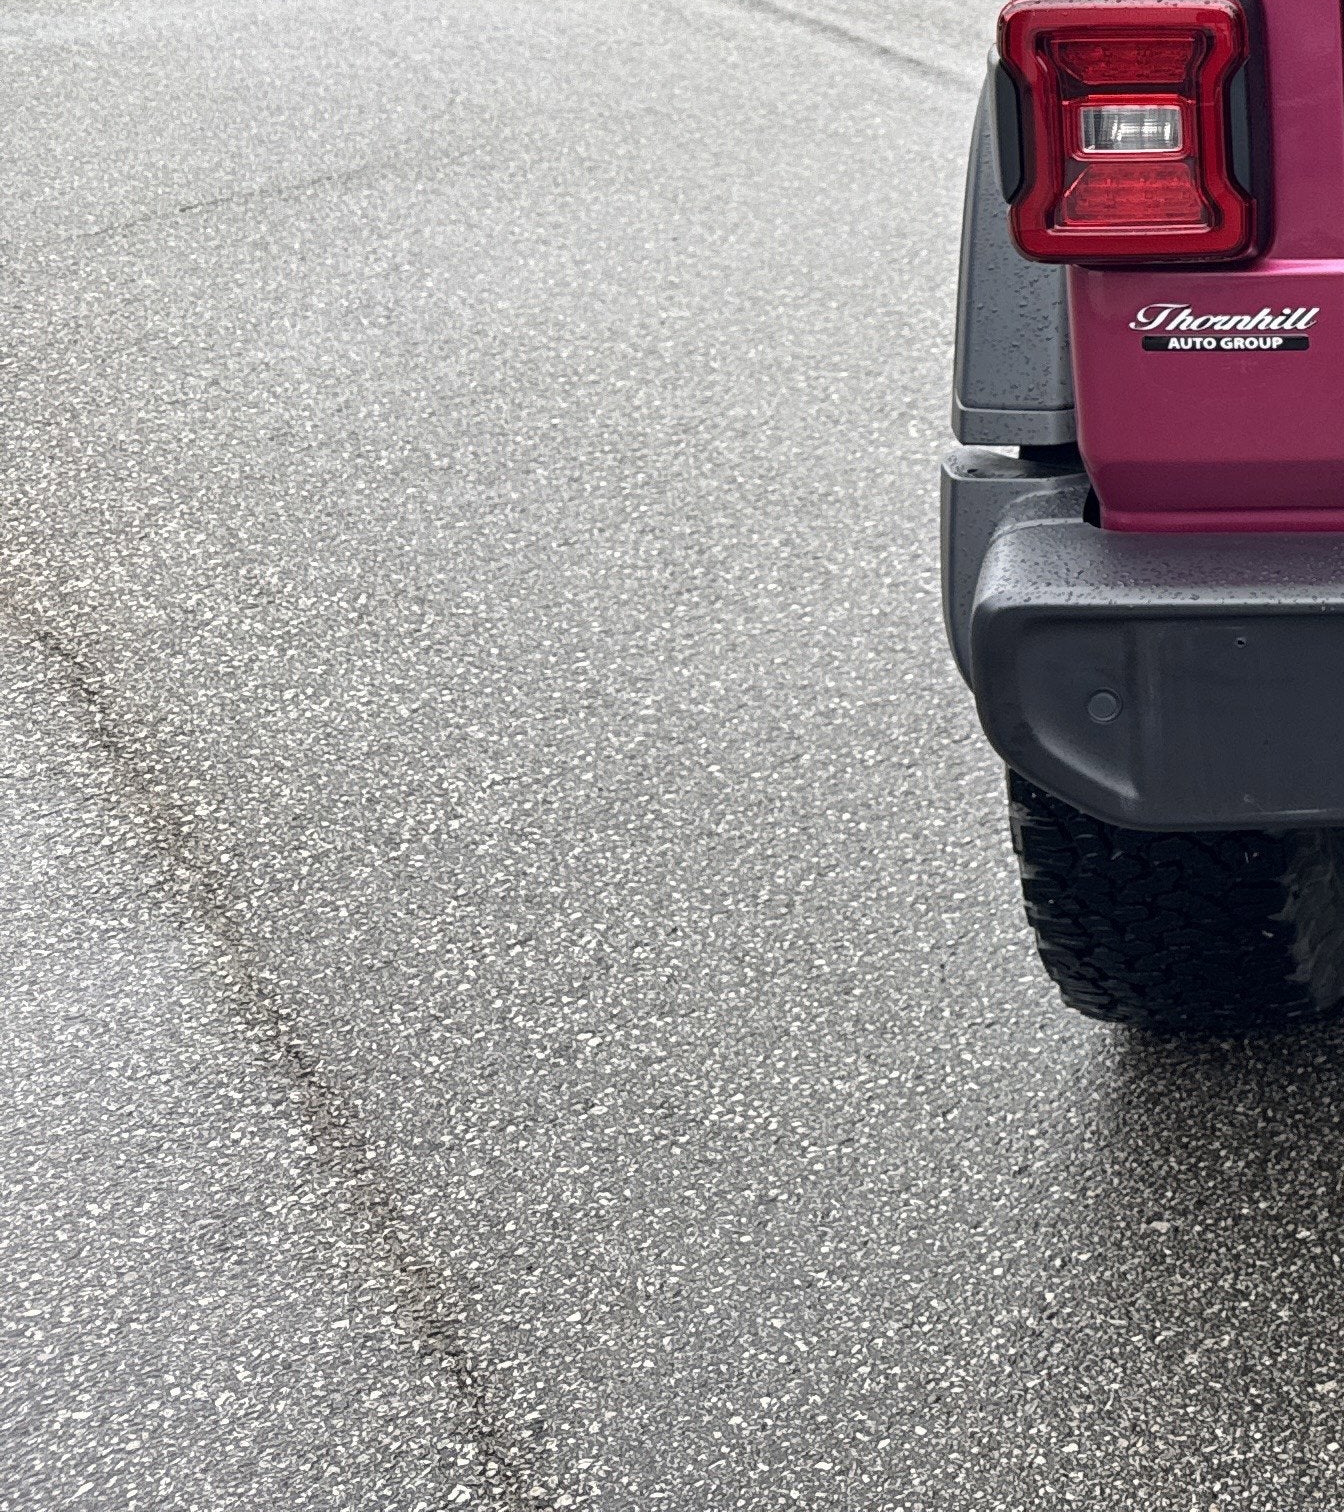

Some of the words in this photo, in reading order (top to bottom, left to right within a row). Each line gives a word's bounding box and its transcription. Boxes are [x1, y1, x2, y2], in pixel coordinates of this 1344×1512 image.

[1128, 303, 1320, 331] Thornhill
[1167, 337, 1217, 350] AUTO
[1220, 337, 1283, 350] GROUP
